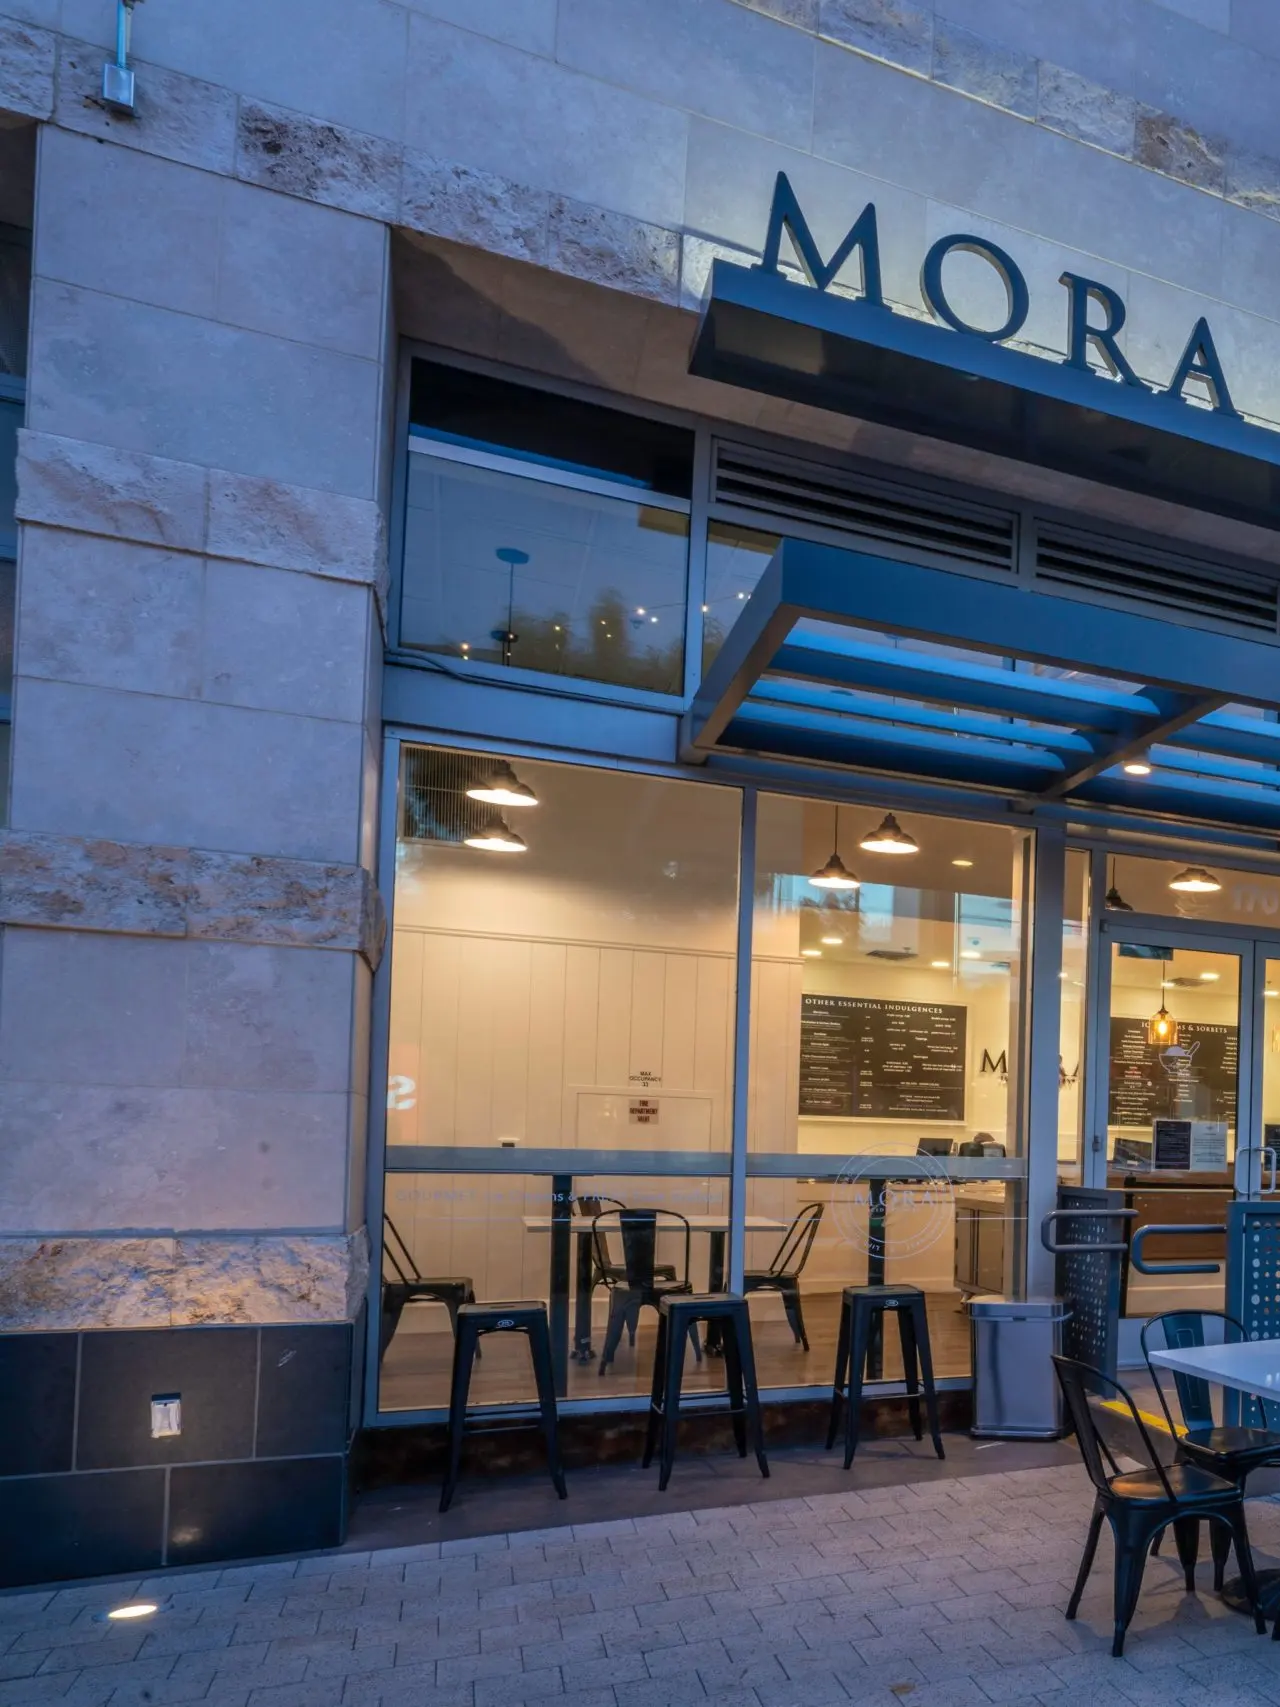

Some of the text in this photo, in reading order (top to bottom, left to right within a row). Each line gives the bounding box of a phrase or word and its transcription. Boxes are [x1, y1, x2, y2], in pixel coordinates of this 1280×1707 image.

[750, 171, 1244, 421] MORA
[805, 998, 943, 1014] OTHER ESSENTIAL INDULGENCES
[1196, 1025, 1228, 1033] SORBETS
[629, 1107, 658, 1115] DEPARTMENT
